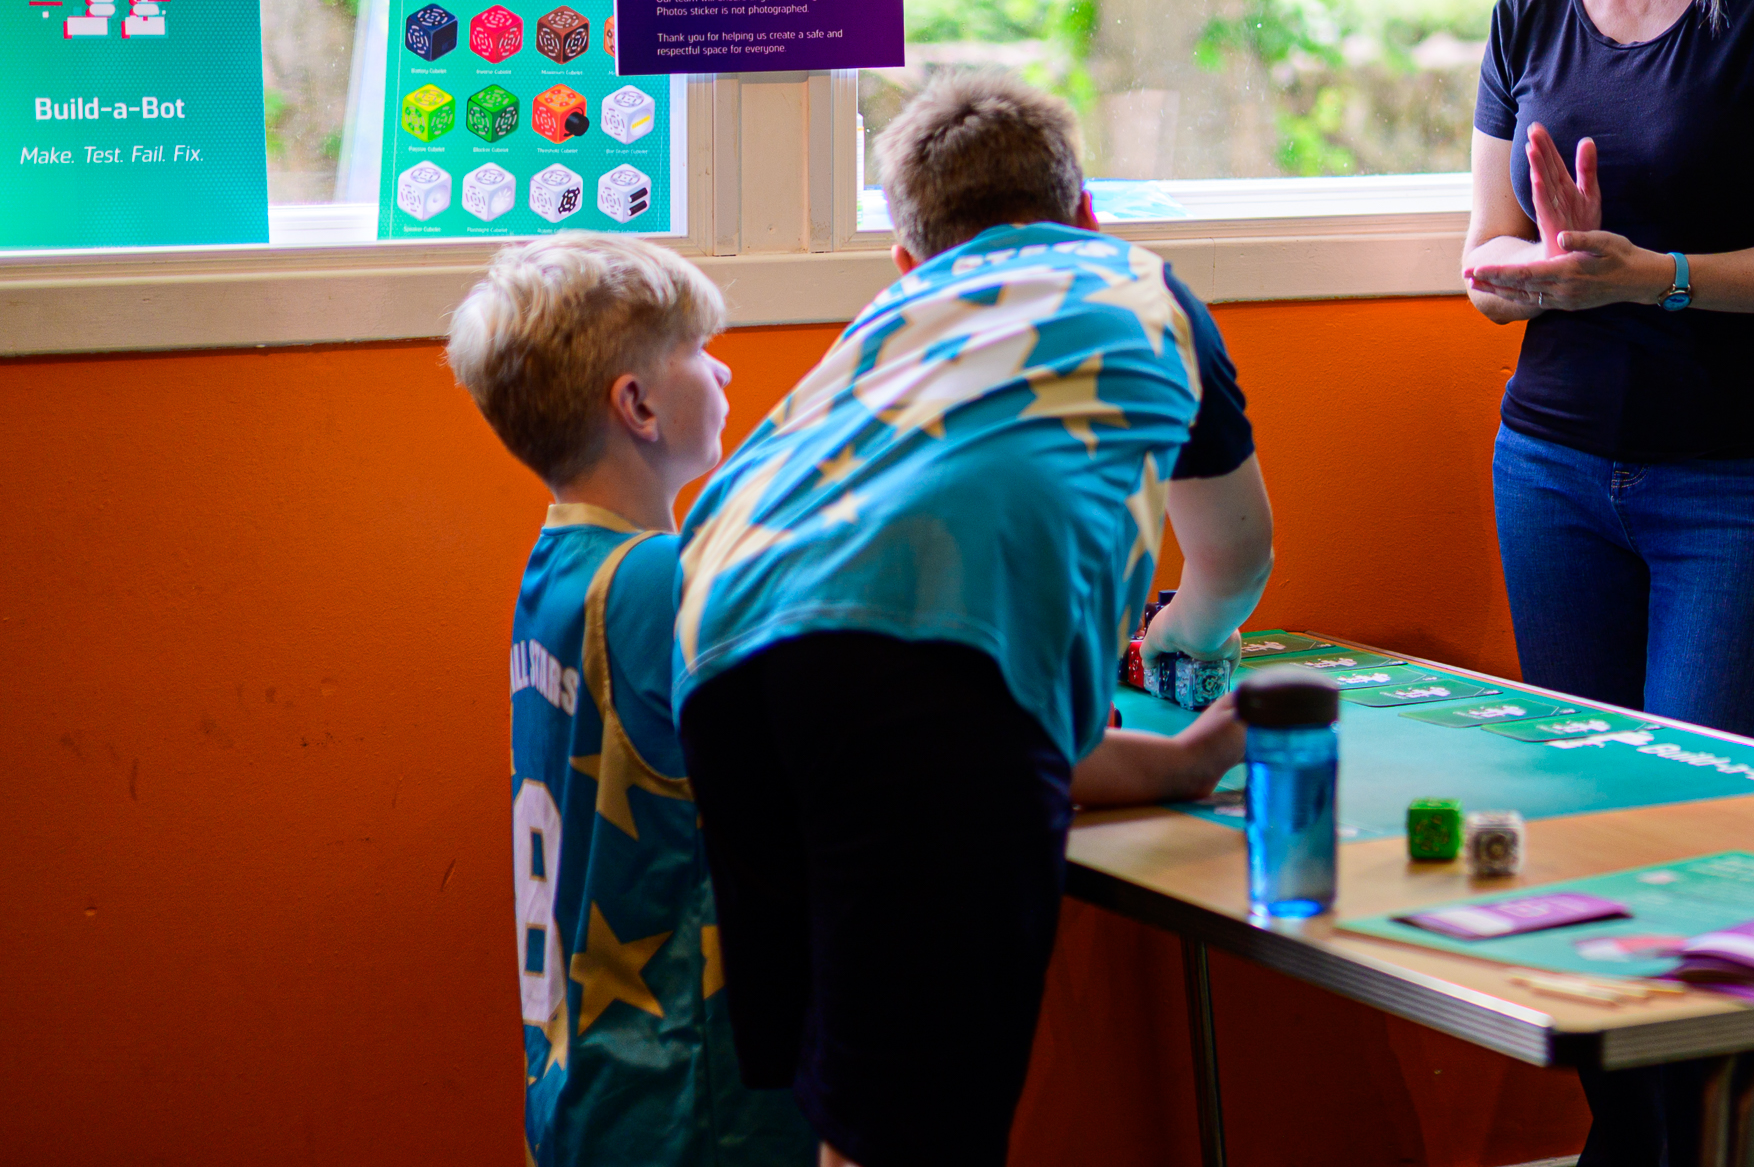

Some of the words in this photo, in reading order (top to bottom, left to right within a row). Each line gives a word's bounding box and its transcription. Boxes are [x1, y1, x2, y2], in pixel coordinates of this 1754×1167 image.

[657, 6, 687, 15] Photos
[691, 6, 718, 15] sticker
[732, 6, 745, 14] not
[749, 3, 808, 15] photographed.
[658, 32, 684, 42] Thank
[688, 34, 704, 43] you
[708, 31, 718, 40] for
[723, 31, 753, 41] helping
[770, 31, 795, 39] create
[807, 29, 824, 38] safe
[827, 28, 842, 37] and
[658, 45, 700, 56] respectful
[703, 46, 727, 55] space
[731, 44, 742, 53] for
[745, 45, 785, 54] everyone.
[35, 96, 185, 121] Build-a-Bot
[20, 147, 74, 164] Make.
[84, 146, 123, 163] Test.
[132, 145, 165, 162] Fail.
[174, 145, 203, 161] Fix.
